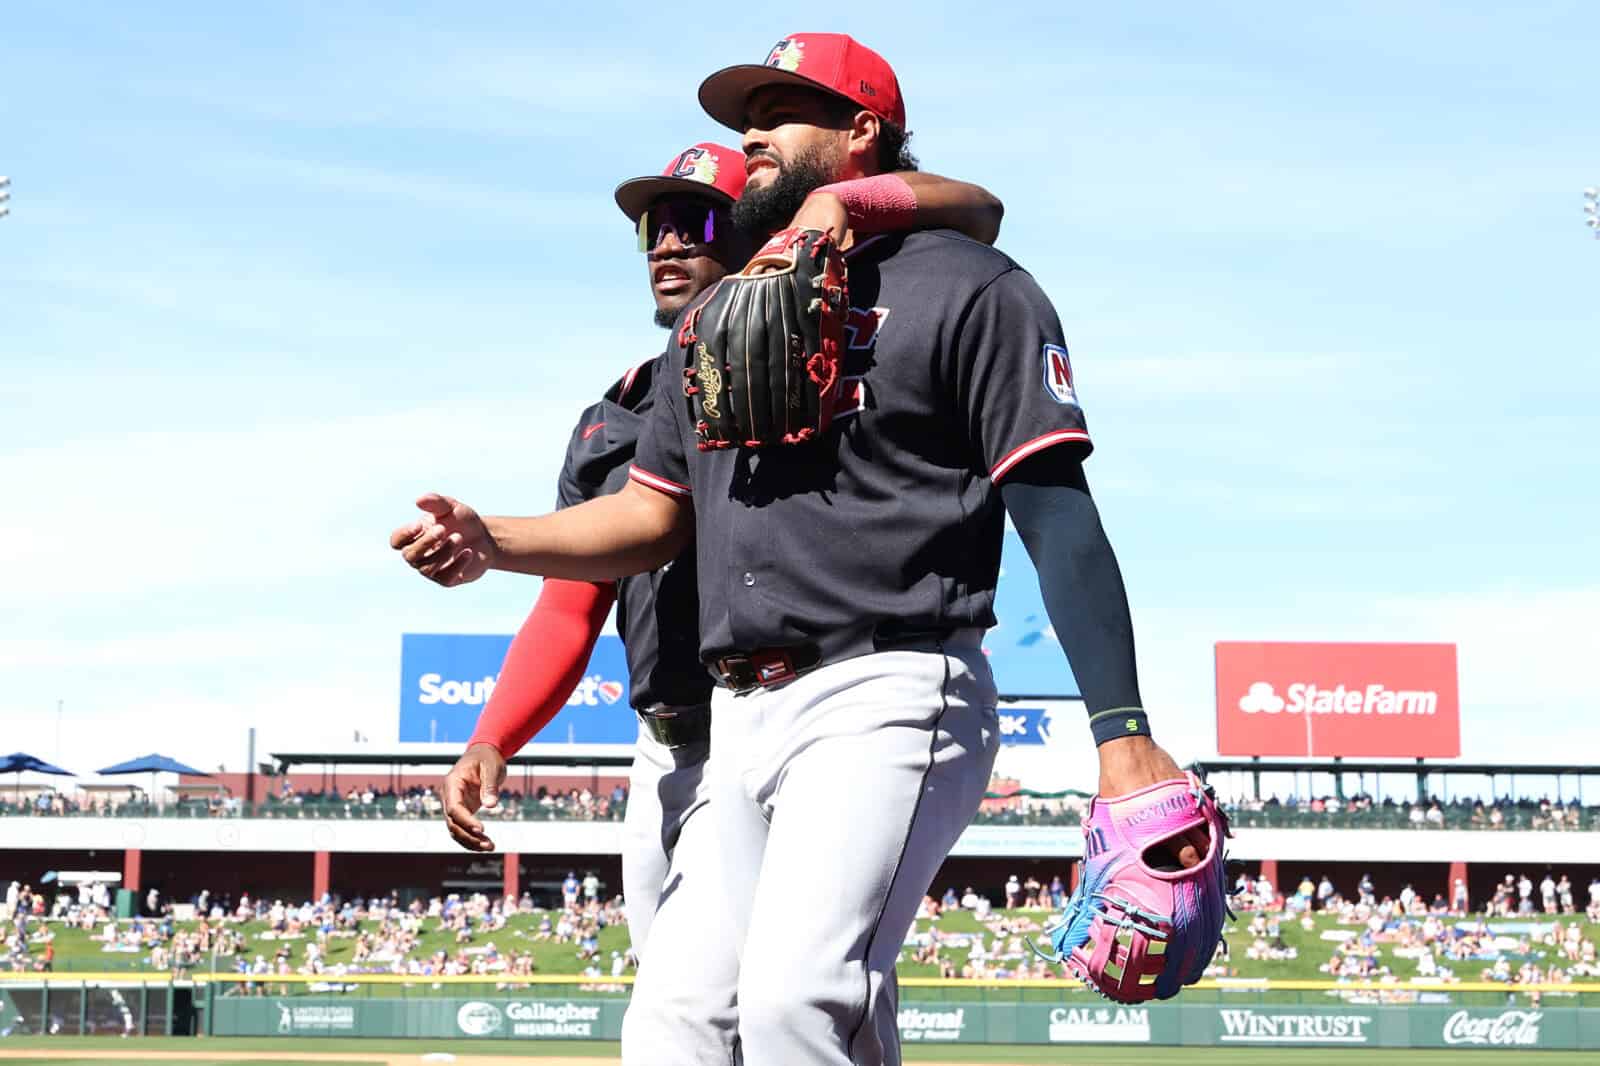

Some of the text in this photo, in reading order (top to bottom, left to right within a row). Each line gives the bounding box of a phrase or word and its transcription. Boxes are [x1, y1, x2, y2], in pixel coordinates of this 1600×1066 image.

[672, 147, 705, 177] C
[506, 1002, 600, 1023] Gallagher
[1220, 1009, 1372, 1037] WINTRUST
[514, 1023, 592, 1036] INSURANCE
